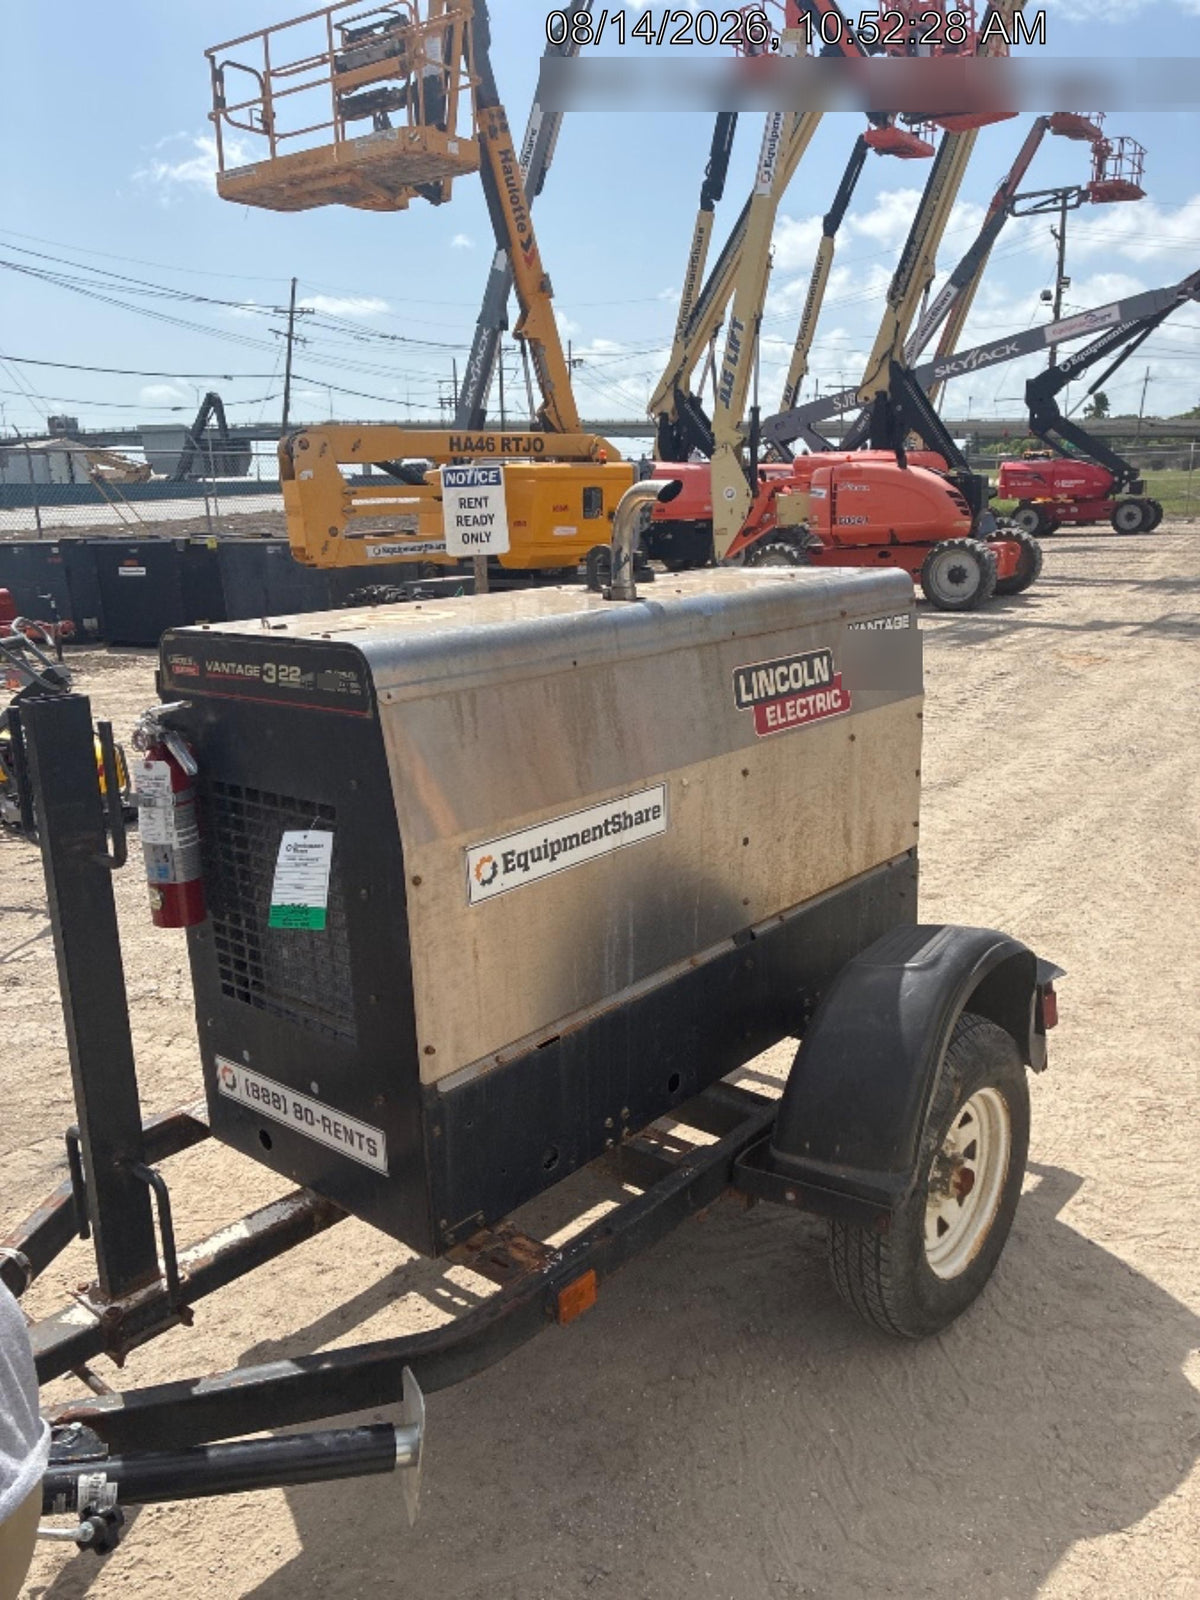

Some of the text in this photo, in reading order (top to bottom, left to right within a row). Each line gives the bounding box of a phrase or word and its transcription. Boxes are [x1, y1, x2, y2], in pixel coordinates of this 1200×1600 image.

[498, 148, 527, 234] Haulotte
[720, 315, 745, 410] JLG LIFT
[934, 341, 1020, 379] SKYJACK
[832, 391, 857, 412] SJ8
[449, 436, 545, 453] HA46 RTJO
[445, 470, 499, 486] NOTICE
[458, 496, 489, 510] RENT
[456, 513, 495, 528] READY
[461, 532, 492, 545] ONLY
[205, 661, 261, 677] VANTAGE
[262, 663, 302, 683] 322
[739, 655, 829, 702] LINCOLN
[766, 689, 843, 727] ELECTRIC
[501, 804, 662, 875] EquipmentShare
[245, 1078, 378, 1158] (888) 80-RENTS
